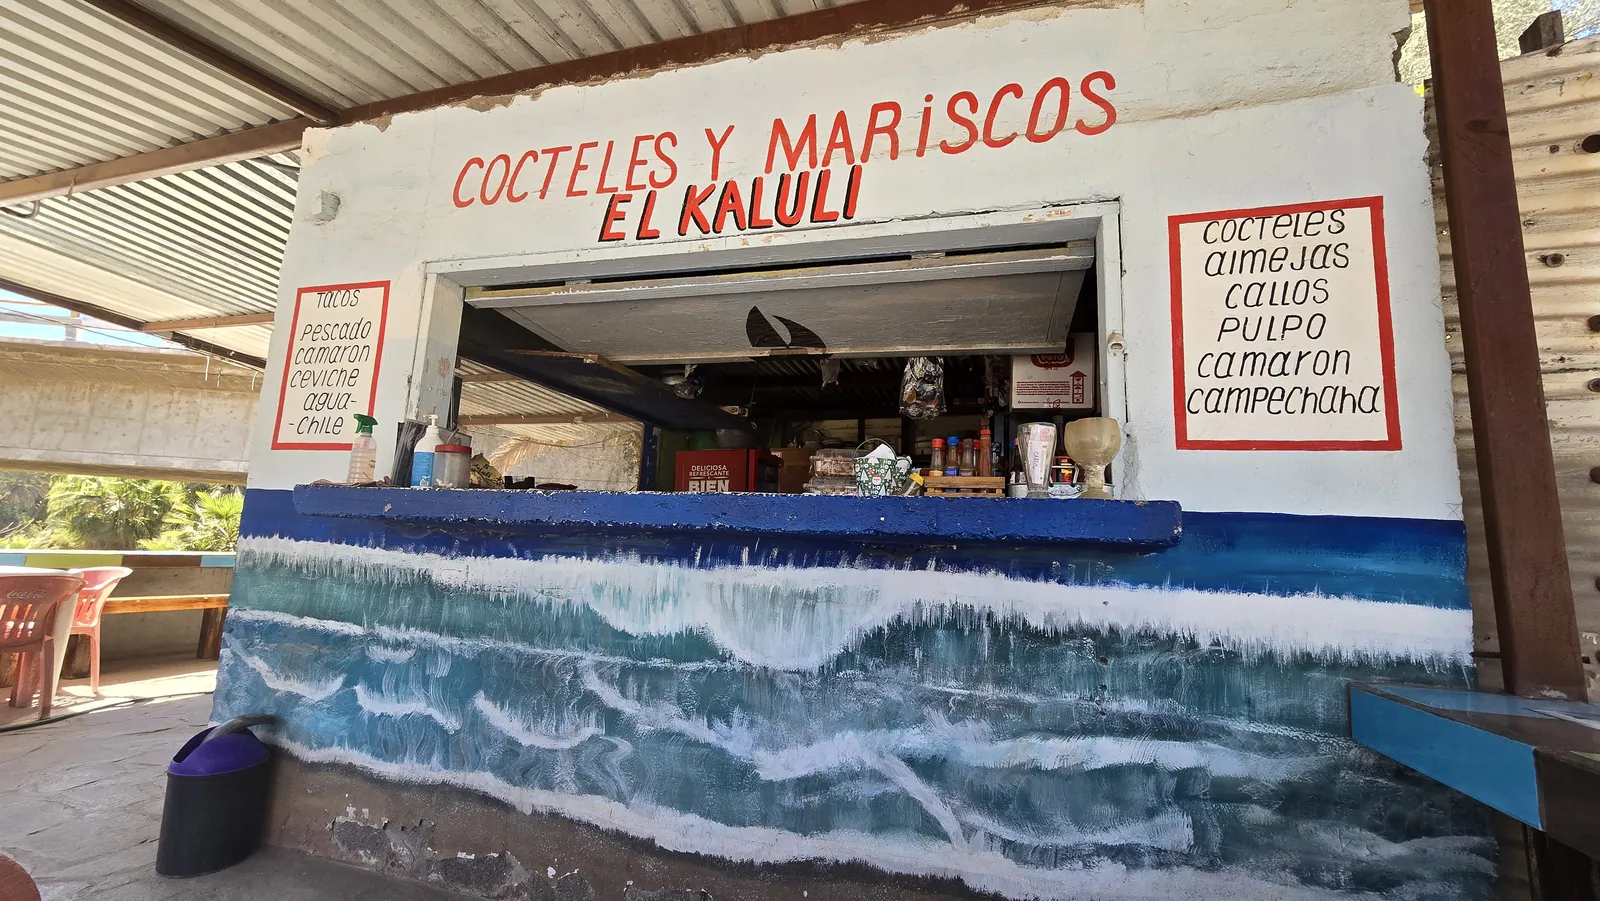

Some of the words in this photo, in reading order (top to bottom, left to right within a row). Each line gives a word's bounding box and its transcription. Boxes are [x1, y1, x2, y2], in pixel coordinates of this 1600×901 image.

[453, 131, 678, 209] COCTELES
[704, 124, 735, 182] Y
[599, 193, 661, 242] EL
[676, 164, 863, 237] KALULI
[1217, 313, 1327, 342] PULPO
[691, 464, 727, 472] DELICIOSA
[688, 479, 730, 493] BIEN
